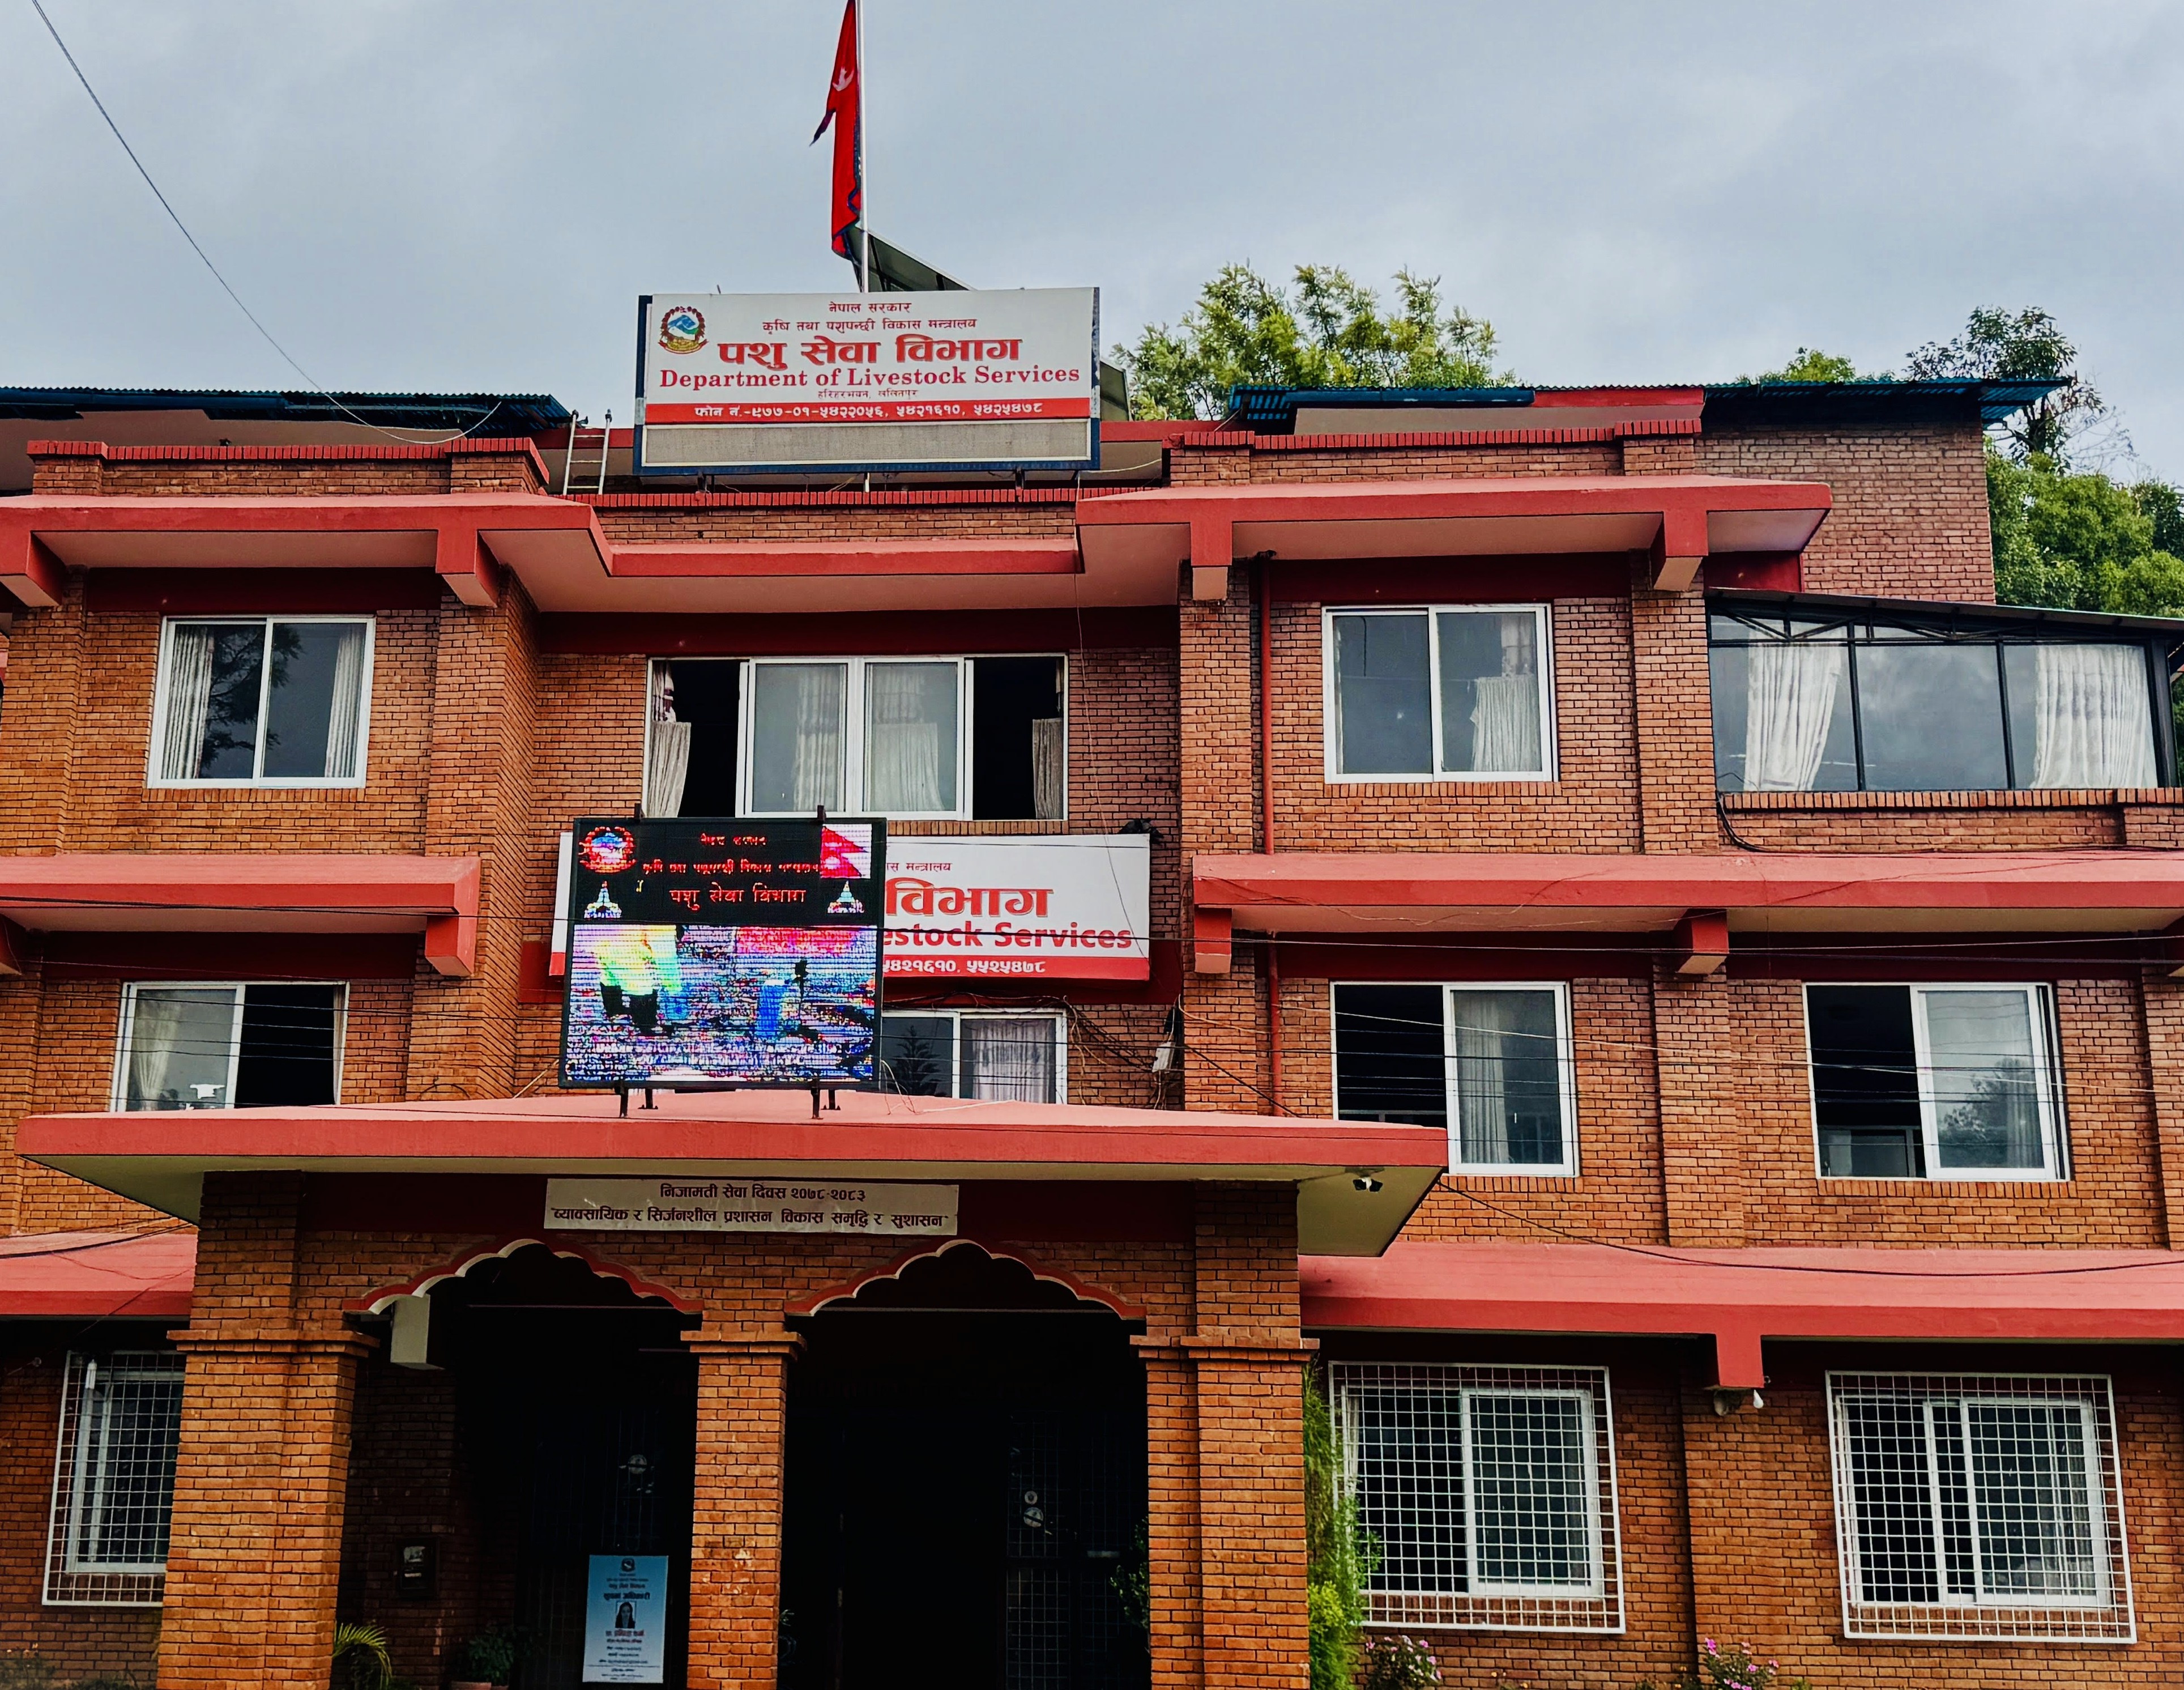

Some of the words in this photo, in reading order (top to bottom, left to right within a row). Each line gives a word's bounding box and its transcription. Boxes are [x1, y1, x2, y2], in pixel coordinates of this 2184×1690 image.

[829, 301, 861, 313] नेपाल
[868, 302, 912, 313] सरकार
[762, 318, 790, 335] कृषि
[826, 318, 876, 334] पशुपन्छी
[882, 318, 922, 330] विकास
[717, 342, 788, 371] पशु
[800, 335, 881, 365] सेवा
[895, 333, 1023, 363] विभाग
[660, 369, 808, 390] Department
[816, 368, 842, 386] of
[847, 366, 966, 386] Livestock
[974, 364, 1080, 383] Services
[694, 405, 723, 417] फोन
[974, 402, 1043, 416] ५४२५४७८
[906, 862, 953, 872] मन्त्रालय
[669, 889, 701, 912] पशु
[709, 882, 745, 902] सेवा
[753, 882, 807, 903] विभाग
[886, 876, 1054, 917] विभाग
[995, 921, 1132, 948] Services
[660, 1183, 718, 1198] निजामती
[723, 1184, 748, 1198] सेवा
[752, 1184, 787, 1199] दिवस
[633, 1210, 643, 1221] र
[648, 1206, 718, 1223] सिर्जनशील
[724, 1210, 773, 1223] प्रशासन
[781, 1208, 824, 1224] विकास
[831, 1210, 869, 1228] समृद्धि
[873, 1213, 885, 1225] र
